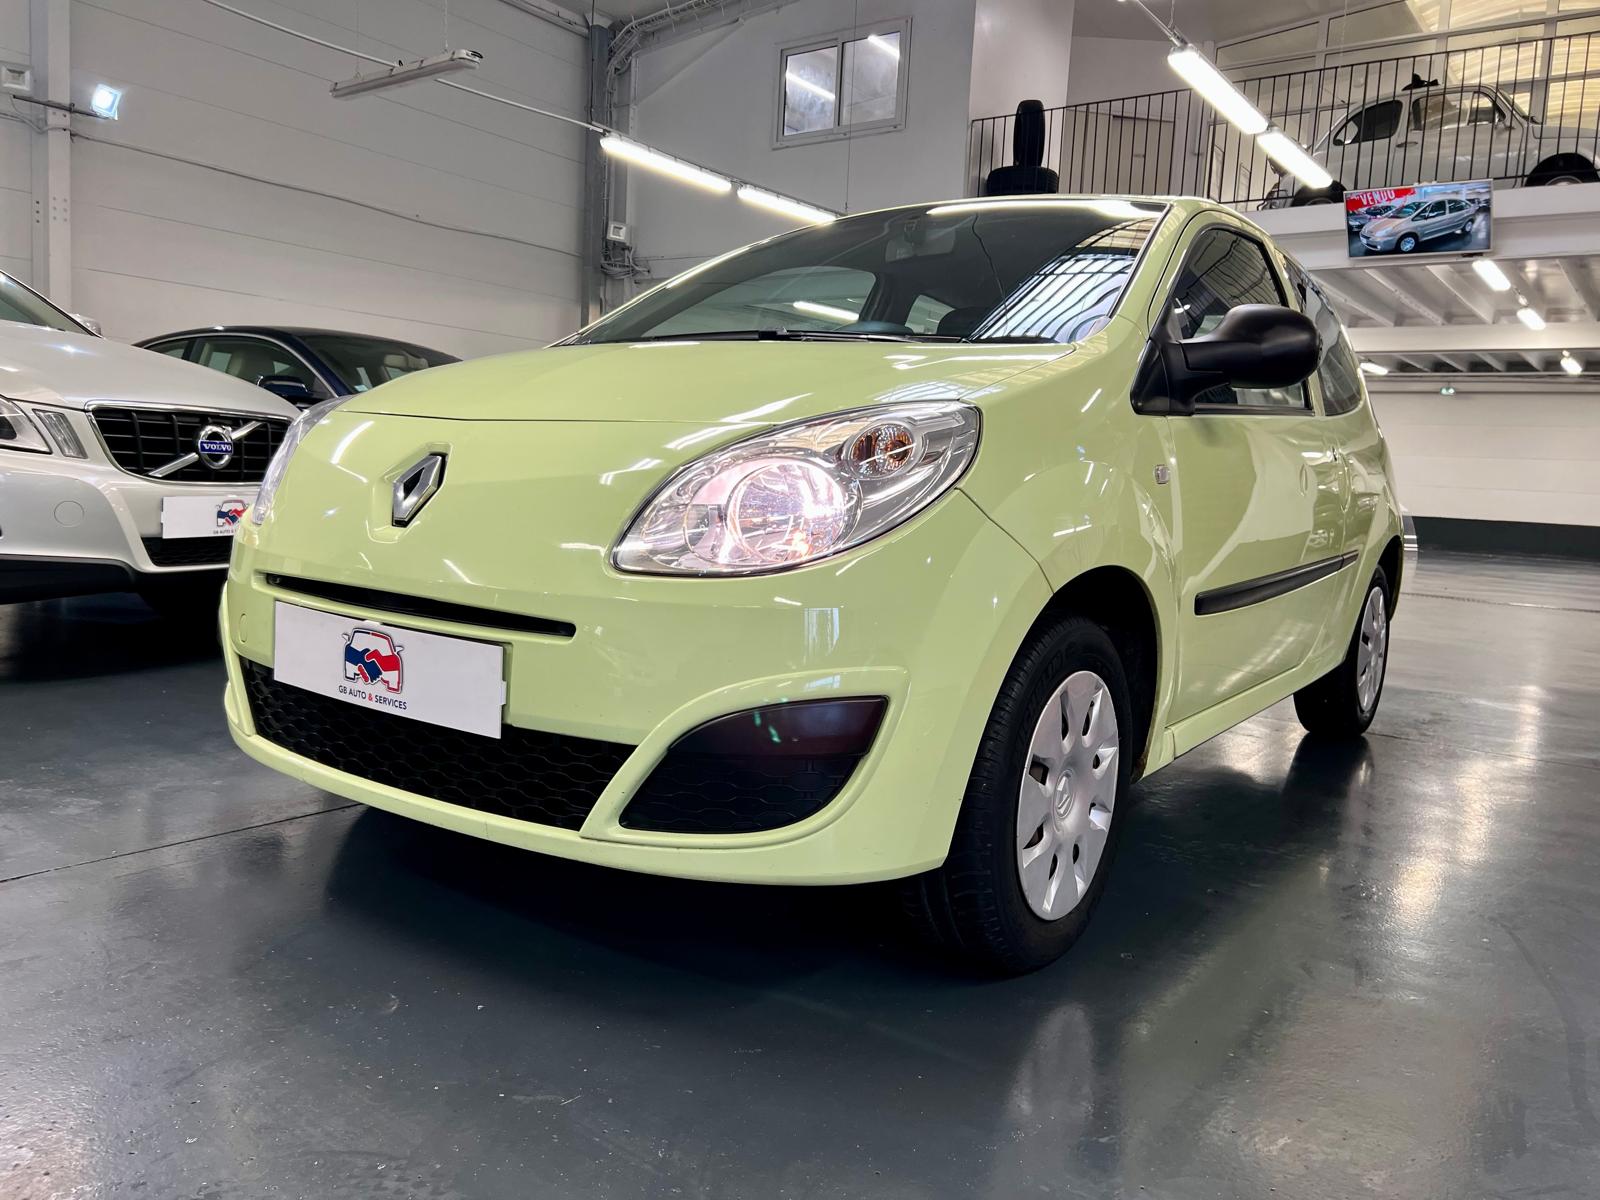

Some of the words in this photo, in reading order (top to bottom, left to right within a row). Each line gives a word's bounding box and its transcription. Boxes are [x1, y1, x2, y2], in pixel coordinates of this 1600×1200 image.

[203, 443, 232, 452] VOLVO
[338, 685, 348, 694] GB
[348, 689, 367, 699] AUTO
[368, 693, 373, 702] &
[375, 694, 407, 710] SERVICES
